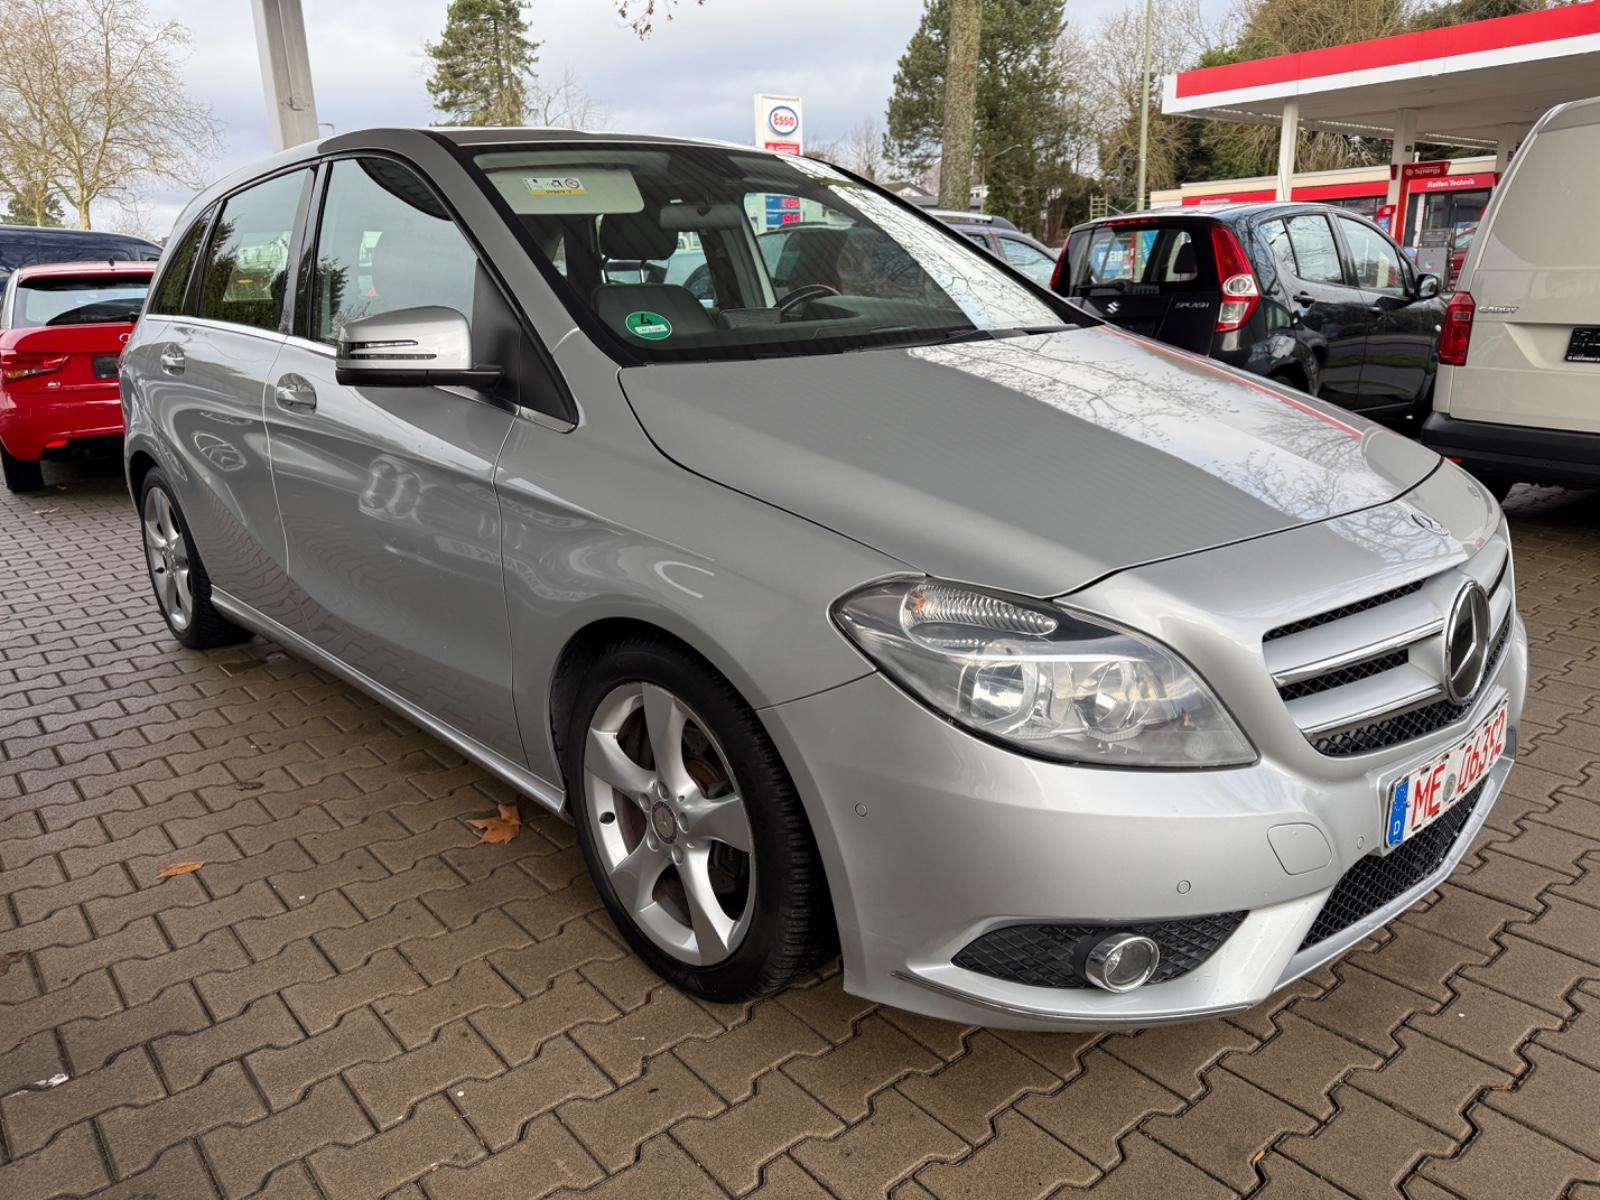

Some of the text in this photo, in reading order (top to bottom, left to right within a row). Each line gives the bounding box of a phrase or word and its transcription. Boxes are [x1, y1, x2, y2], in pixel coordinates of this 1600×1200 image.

[773, 112, 794, 127] Esso
[1449, 178, 1475, 187] Technik
[1175, 301, 1210, 309] SPLASH
[1479, 306, 1520, 314] CADDY
[1411, 763, 1446, 827] ME
[1393, 820, 1401, 836] D
